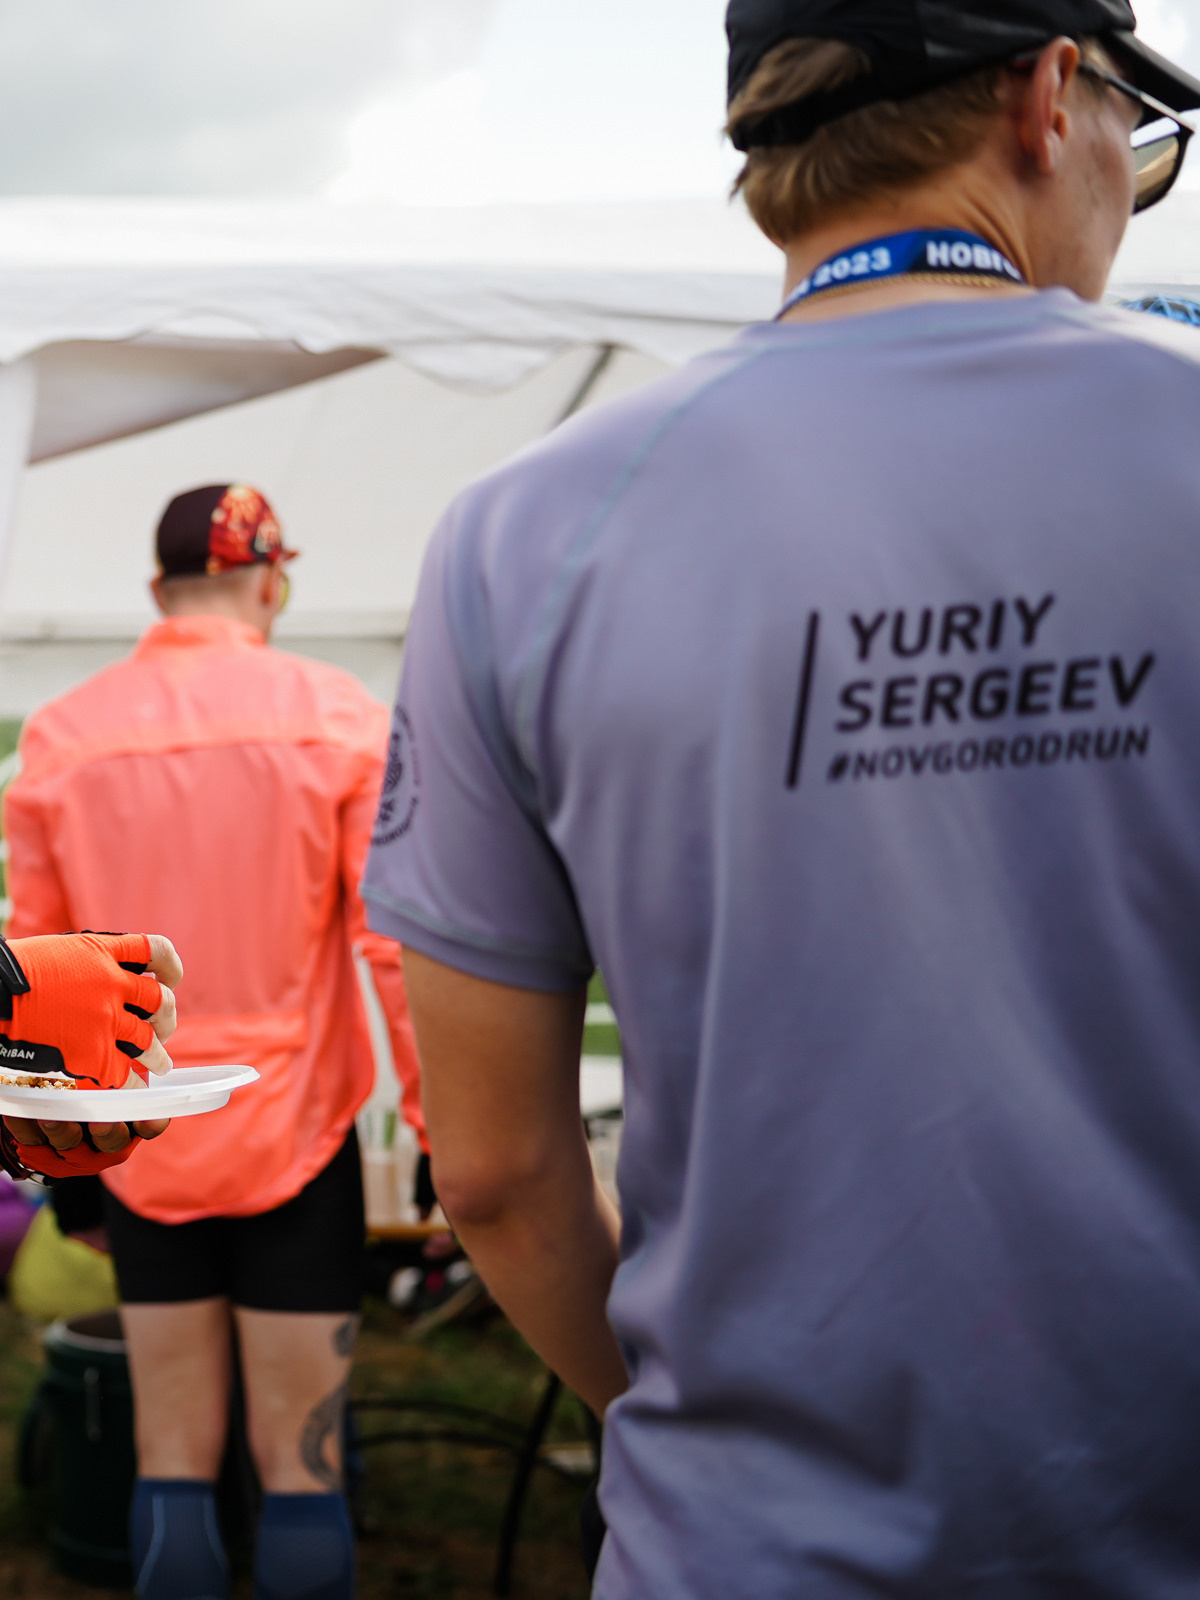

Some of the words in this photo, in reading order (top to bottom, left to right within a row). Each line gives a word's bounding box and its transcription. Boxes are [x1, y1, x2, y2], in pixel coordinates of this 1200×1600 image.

[812, 246, 892, 287] 2023
[849, 593, 1056, 662] YURIY
[834, 651, 1156, 732] SERGEEV
[826, 725, 1151, 784] #NOVGORODRUN
